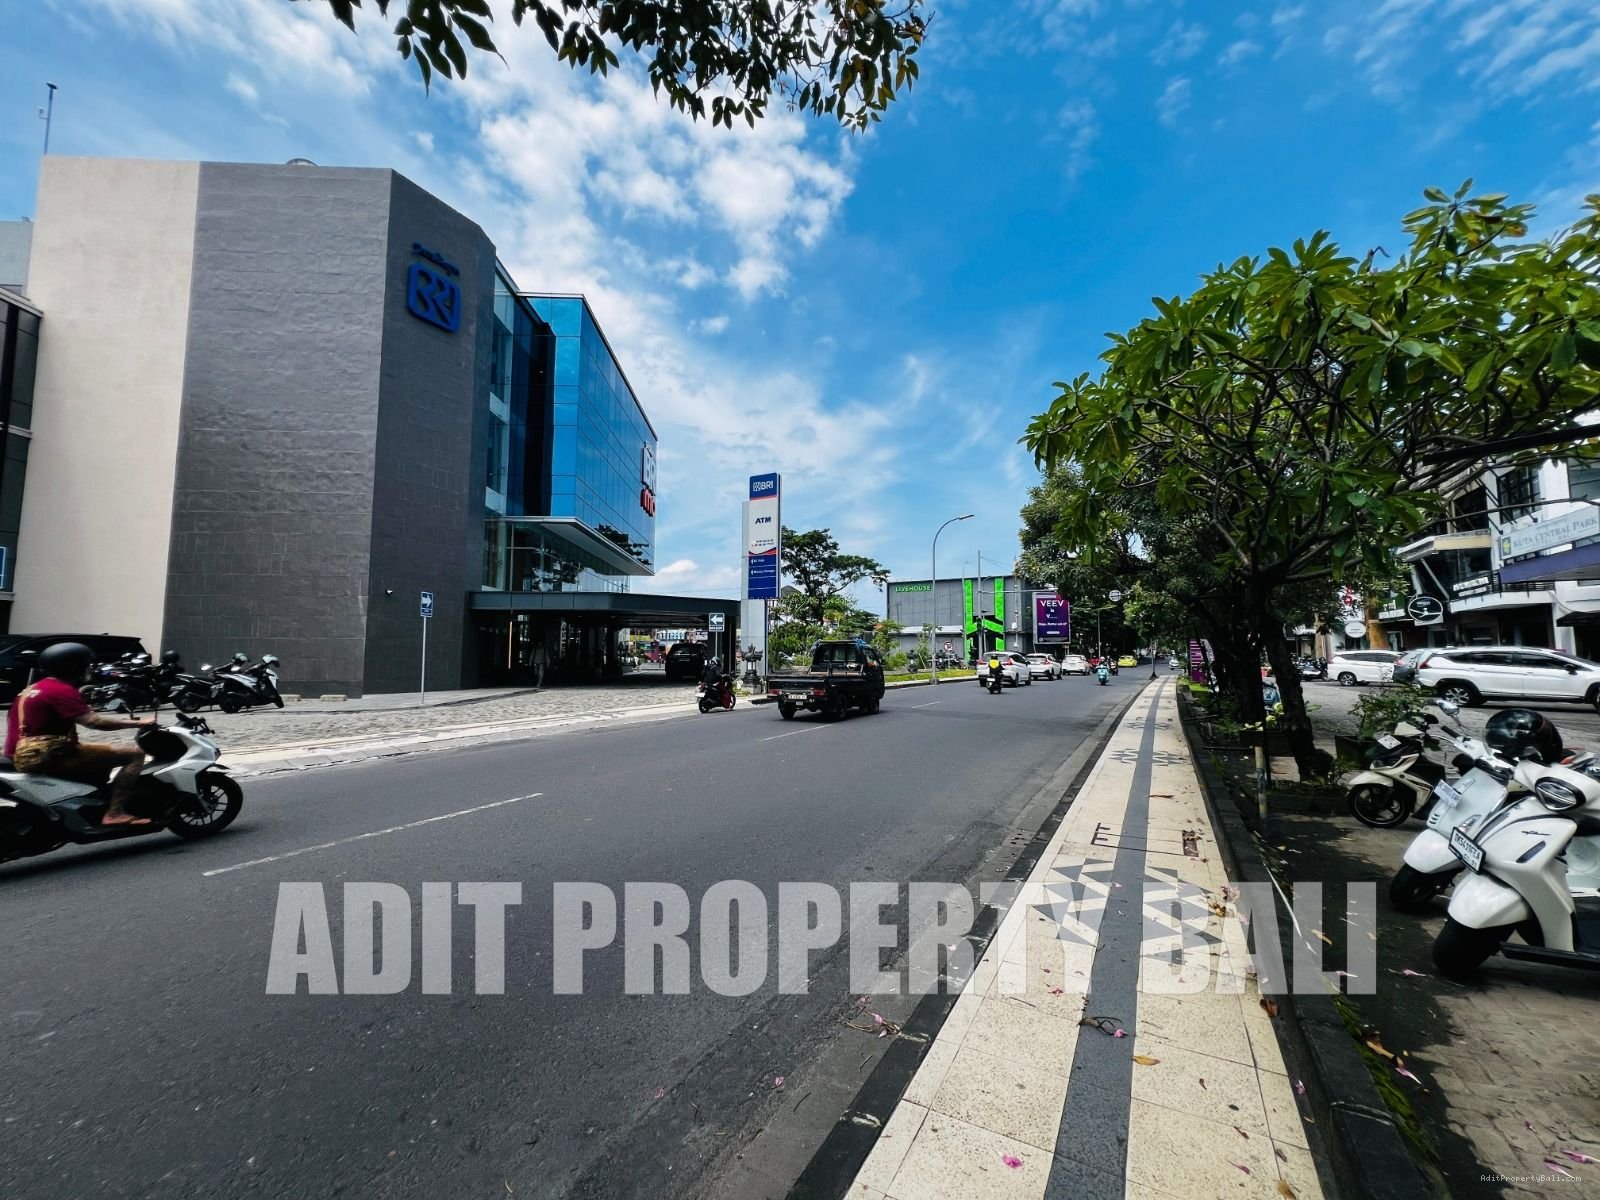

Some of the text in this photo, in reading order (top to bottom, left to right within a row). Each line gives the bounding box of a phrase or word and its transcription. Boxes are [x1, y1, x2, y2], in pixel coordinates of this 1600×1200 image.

[755, 516, 772, 524] ATM
[1535, 525, 1571, 541] CENTRAL
[1573, 516, 1598, 531] PARK
[895, 584, 932, 592] LIVEHOUSE
